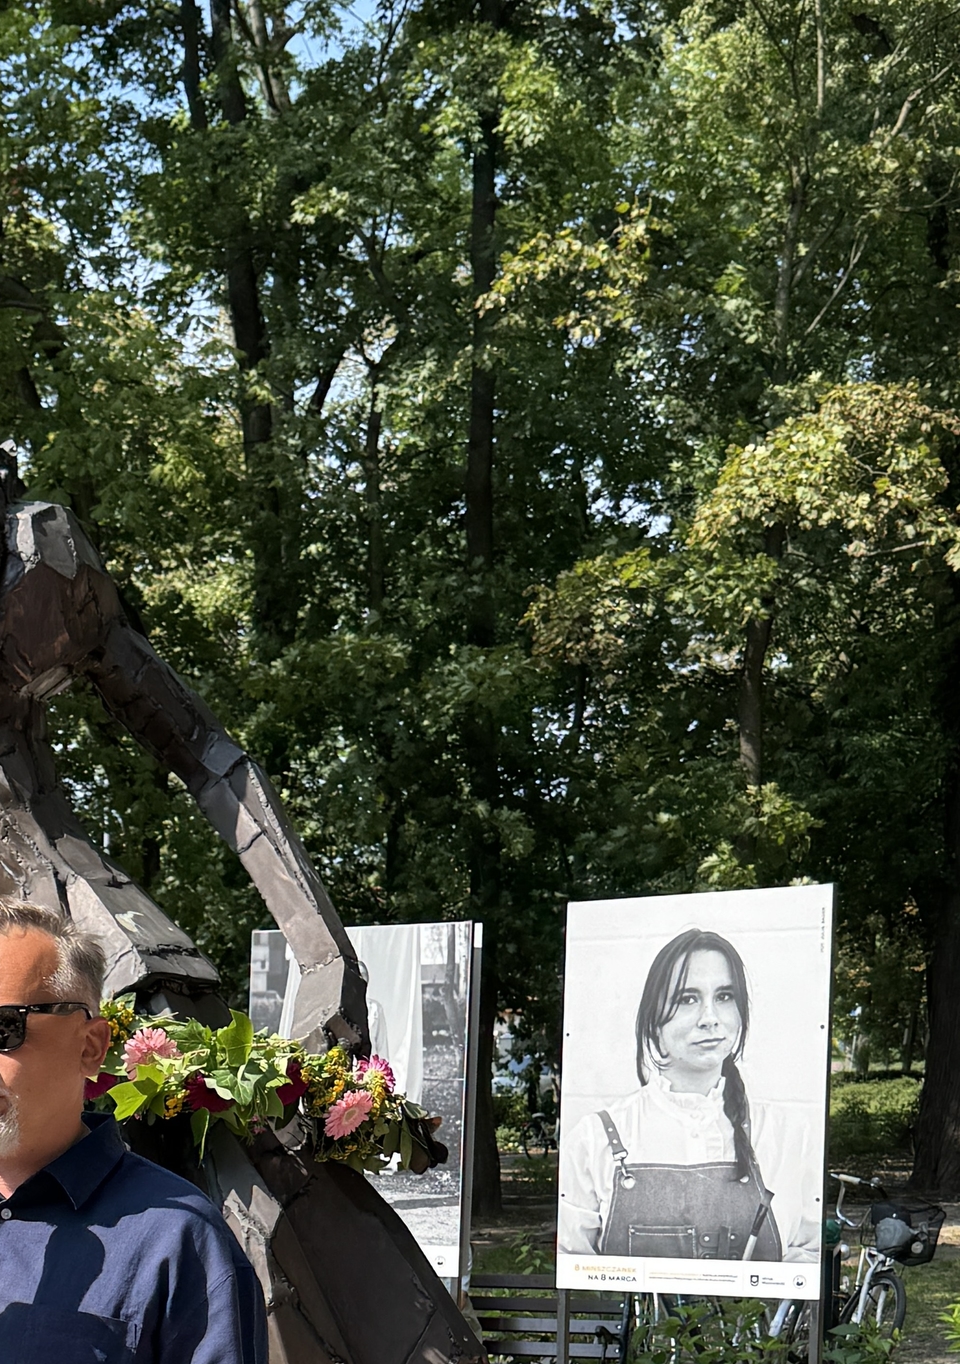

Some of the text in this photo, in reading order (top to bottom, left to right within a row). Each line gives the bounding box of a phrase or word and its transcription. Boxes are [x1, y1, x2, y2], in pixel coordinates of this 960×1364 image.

[574, 1263, 580, 1271] 8
[600, 1273, 607, 1281] 8
[608, 1275, 637, 1283] MARCA
